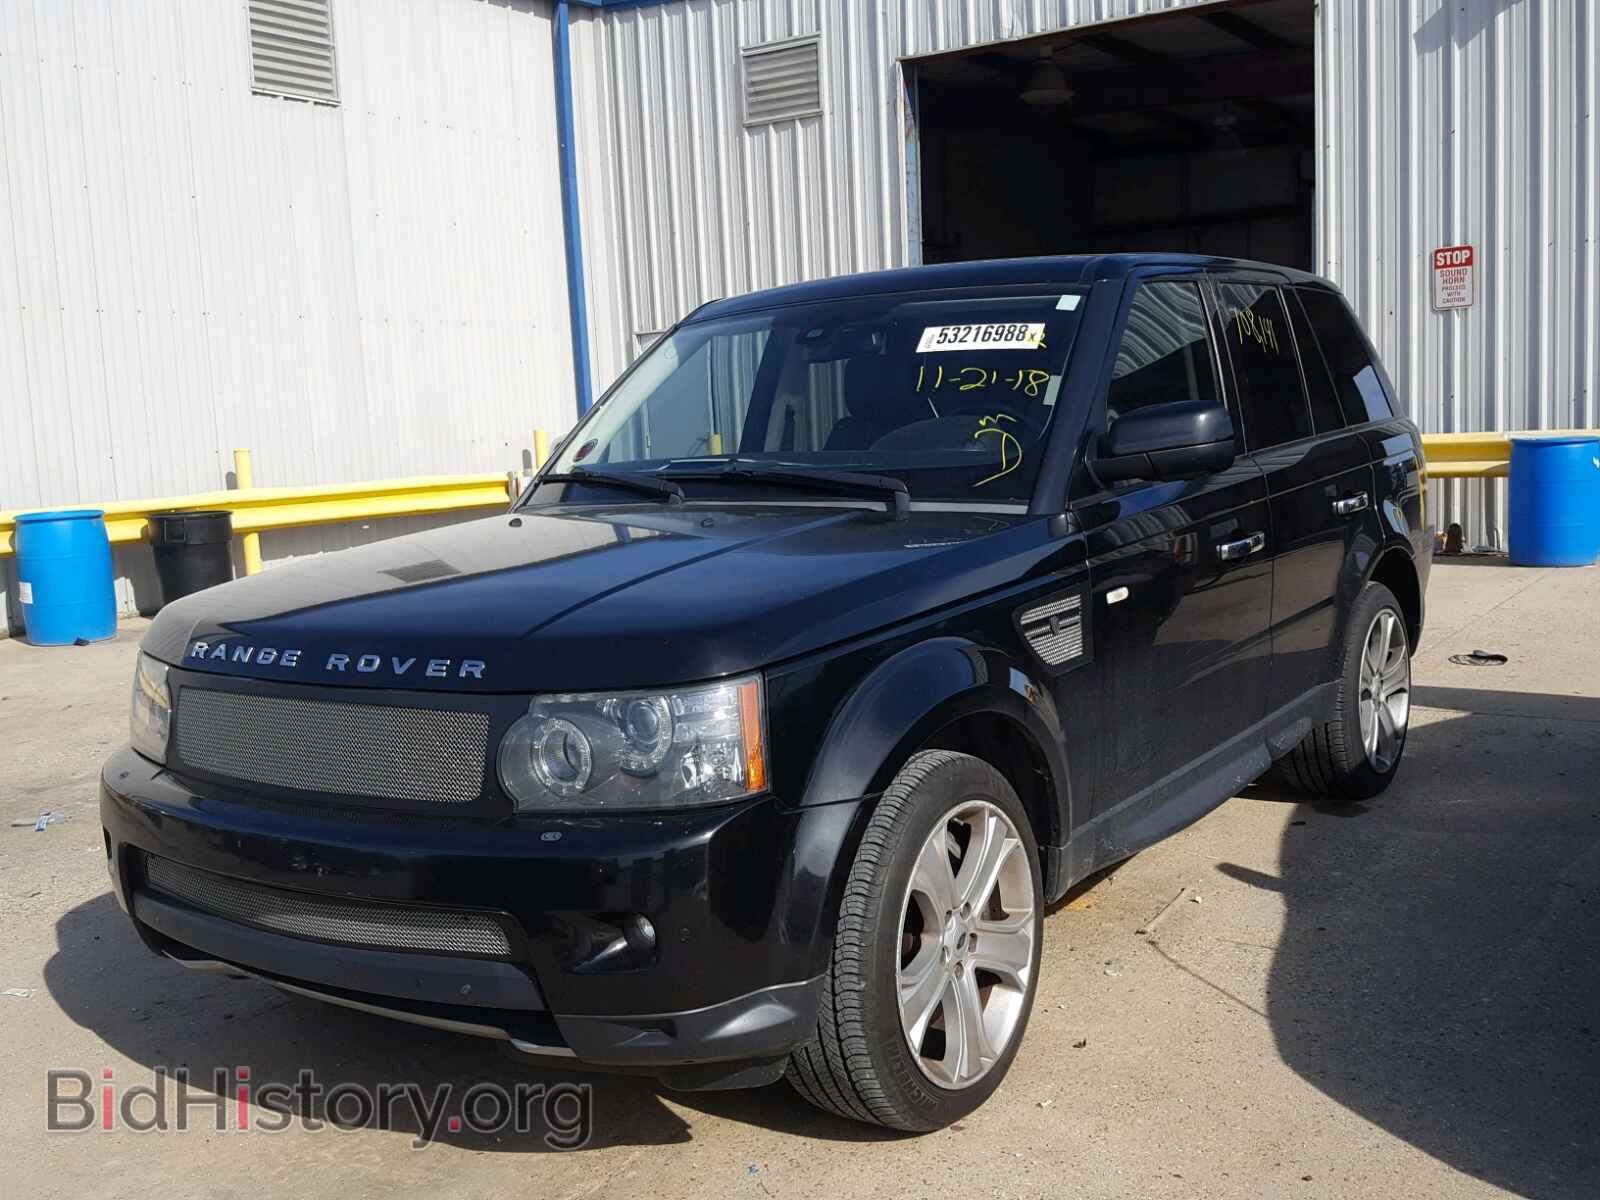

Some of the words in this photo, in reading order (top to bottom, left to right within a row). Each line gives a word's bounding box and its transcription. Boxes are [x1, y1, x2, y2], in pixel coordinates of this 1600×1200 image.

[1436, 250, 1470, 266] STOP
[1440, 268, 1467, 277] SOUND
[936, 324, 1029, 344] 53216988
[916, 365, 1050, 396] 11-21-18
[190, 641, 302, 667] RANGE
[325, 653, 486, 679] ROVER
